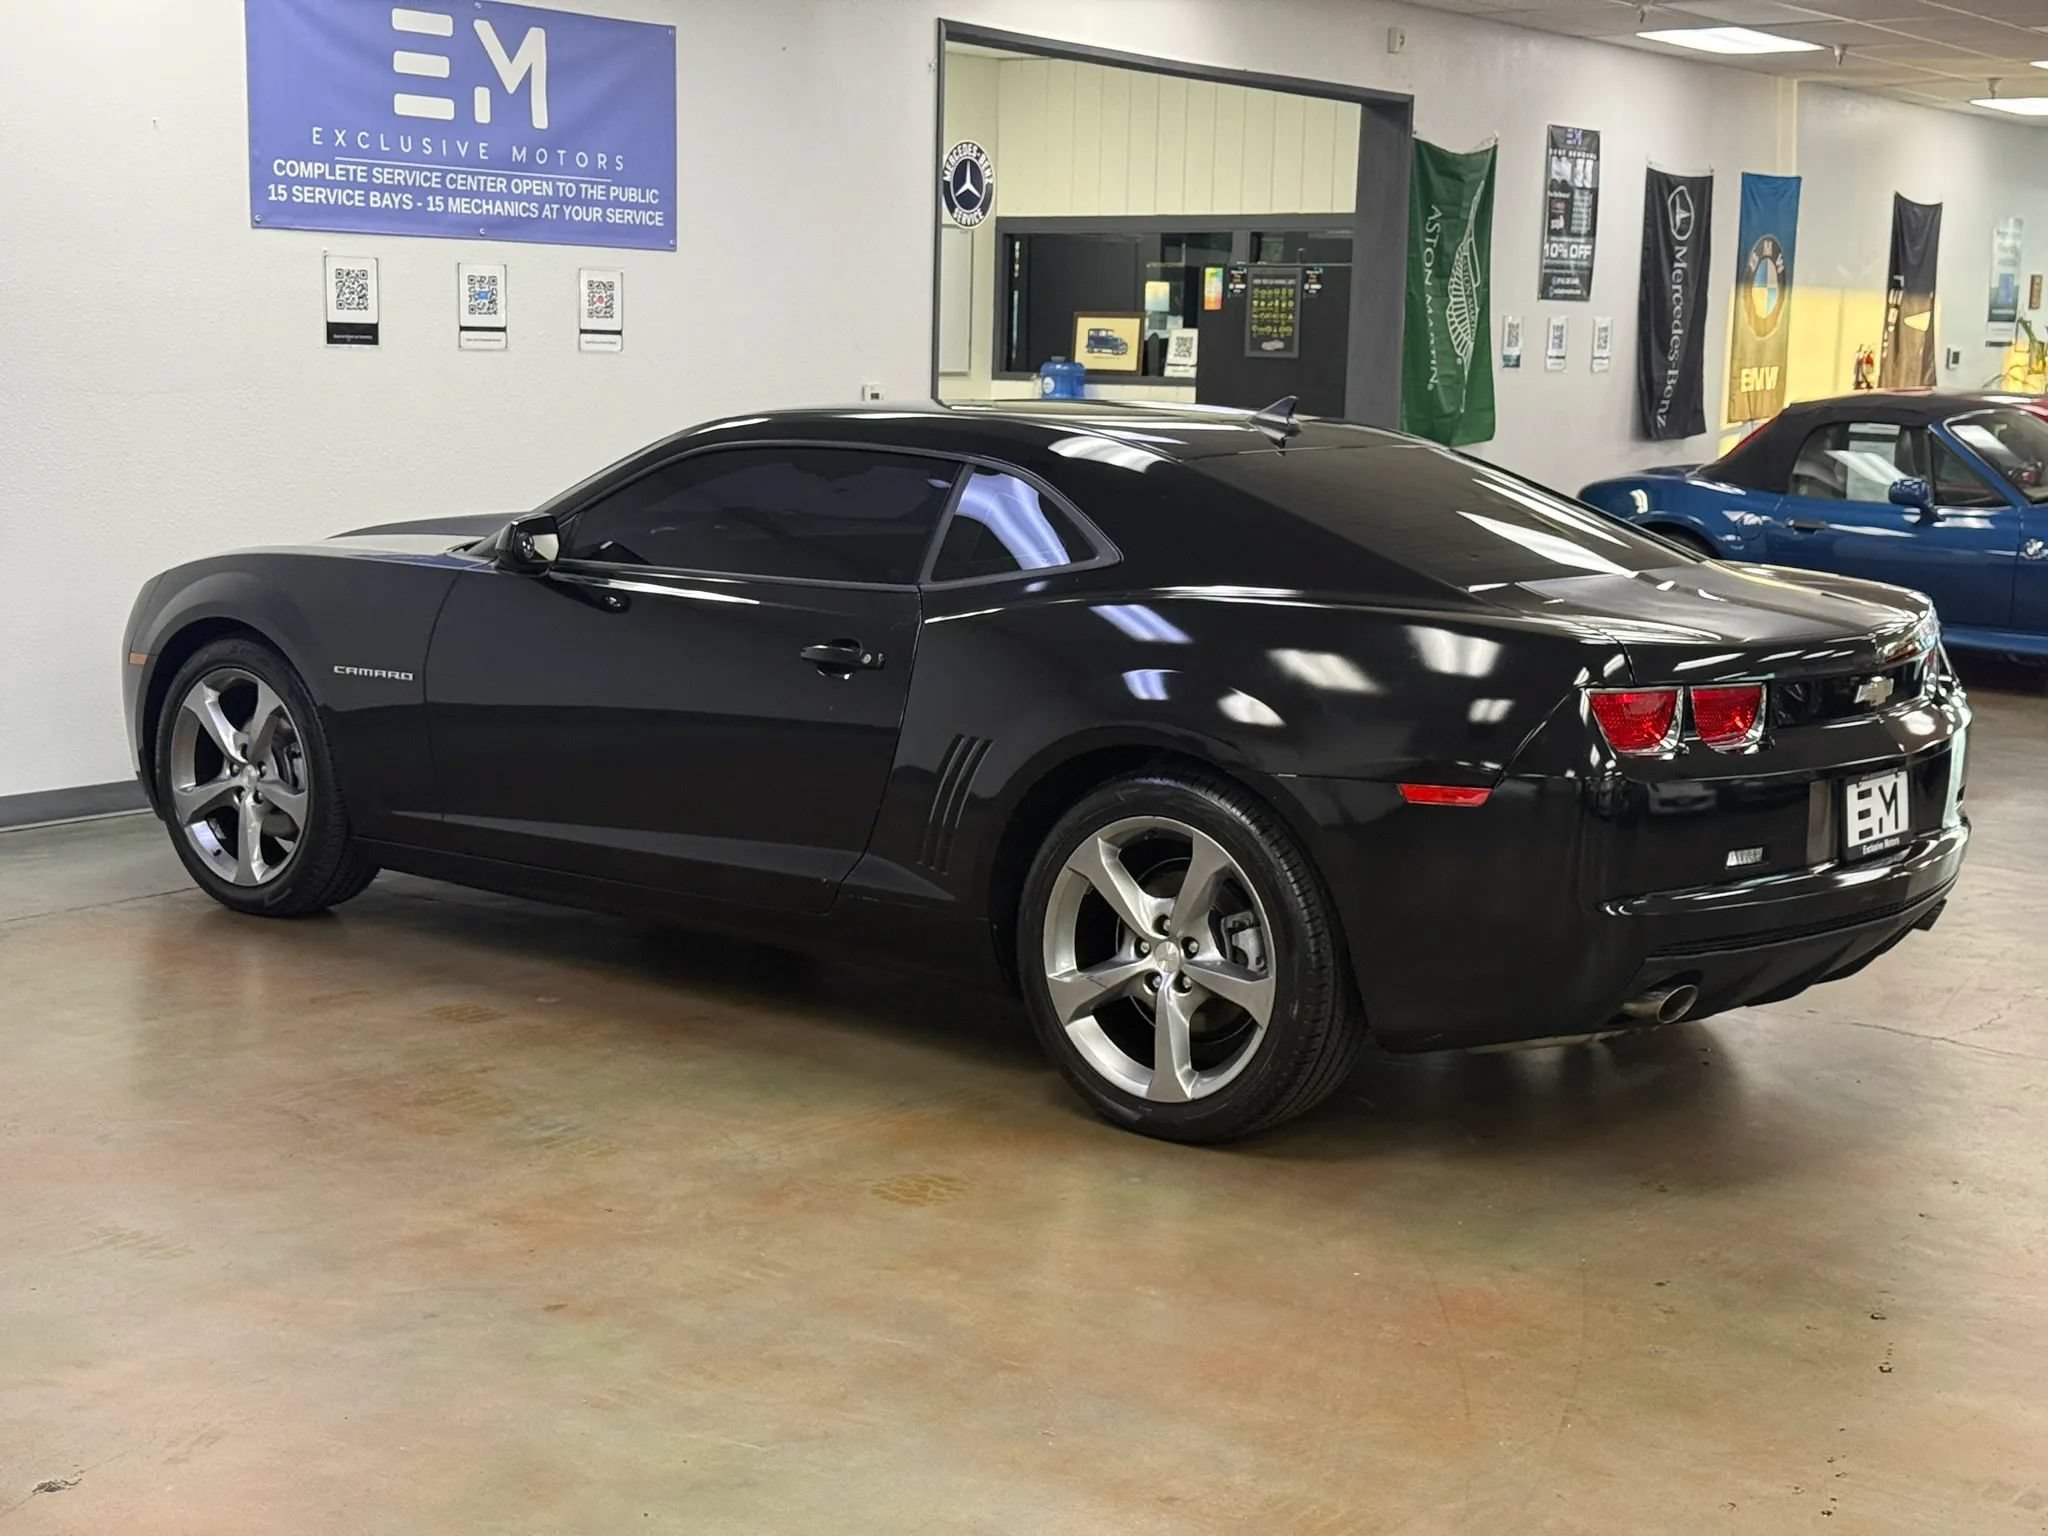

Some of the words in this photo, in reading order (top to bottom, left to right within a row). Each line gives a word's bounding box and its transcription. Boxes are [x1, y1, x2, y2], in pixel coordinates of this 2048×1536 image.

[392, 8, 549, 130] EM
[312, 126, 489, 160] EXCLUSIVE
[512, 145, 624, 171] MOTORS
[272, 159, 368, 183] COMPLETE
[371, 167, 442, 188] SERVICE
[445, 173, 507, 193] CENTER
[511, 178, 553, 197] OPEN
[556, 181, 576, 198] TO
[579, 183, 607, 201] THE
[609, 186, 659, 204] PUBLIC
[267, 183, 288, 202] 15
[291, 184, 366, 207] SERVICE
[369, 191, 413, 210] BAYS
[426, 195, 445, 212] 15
[448, 197, 539, 218] MECHANICS
[541, 203, 560, 219] AT
[562, 204, 603, 222] YOUR
[605, 208, 664, 226] SERVICE
[953, 207, 984, 226] SERVICE
[1424, 204, 1442, 286] ASTON
[1543, 243, 1568, 259] 10%
[1569, 244, 1593, 259] OFF
[1656, 245, 1688, 428] Mercedes-Benz
[1740, 366, 1779, 393] BMW
[333, 665, 414, 681] CAMARO
[1857, 781, 1899, 840] EM
